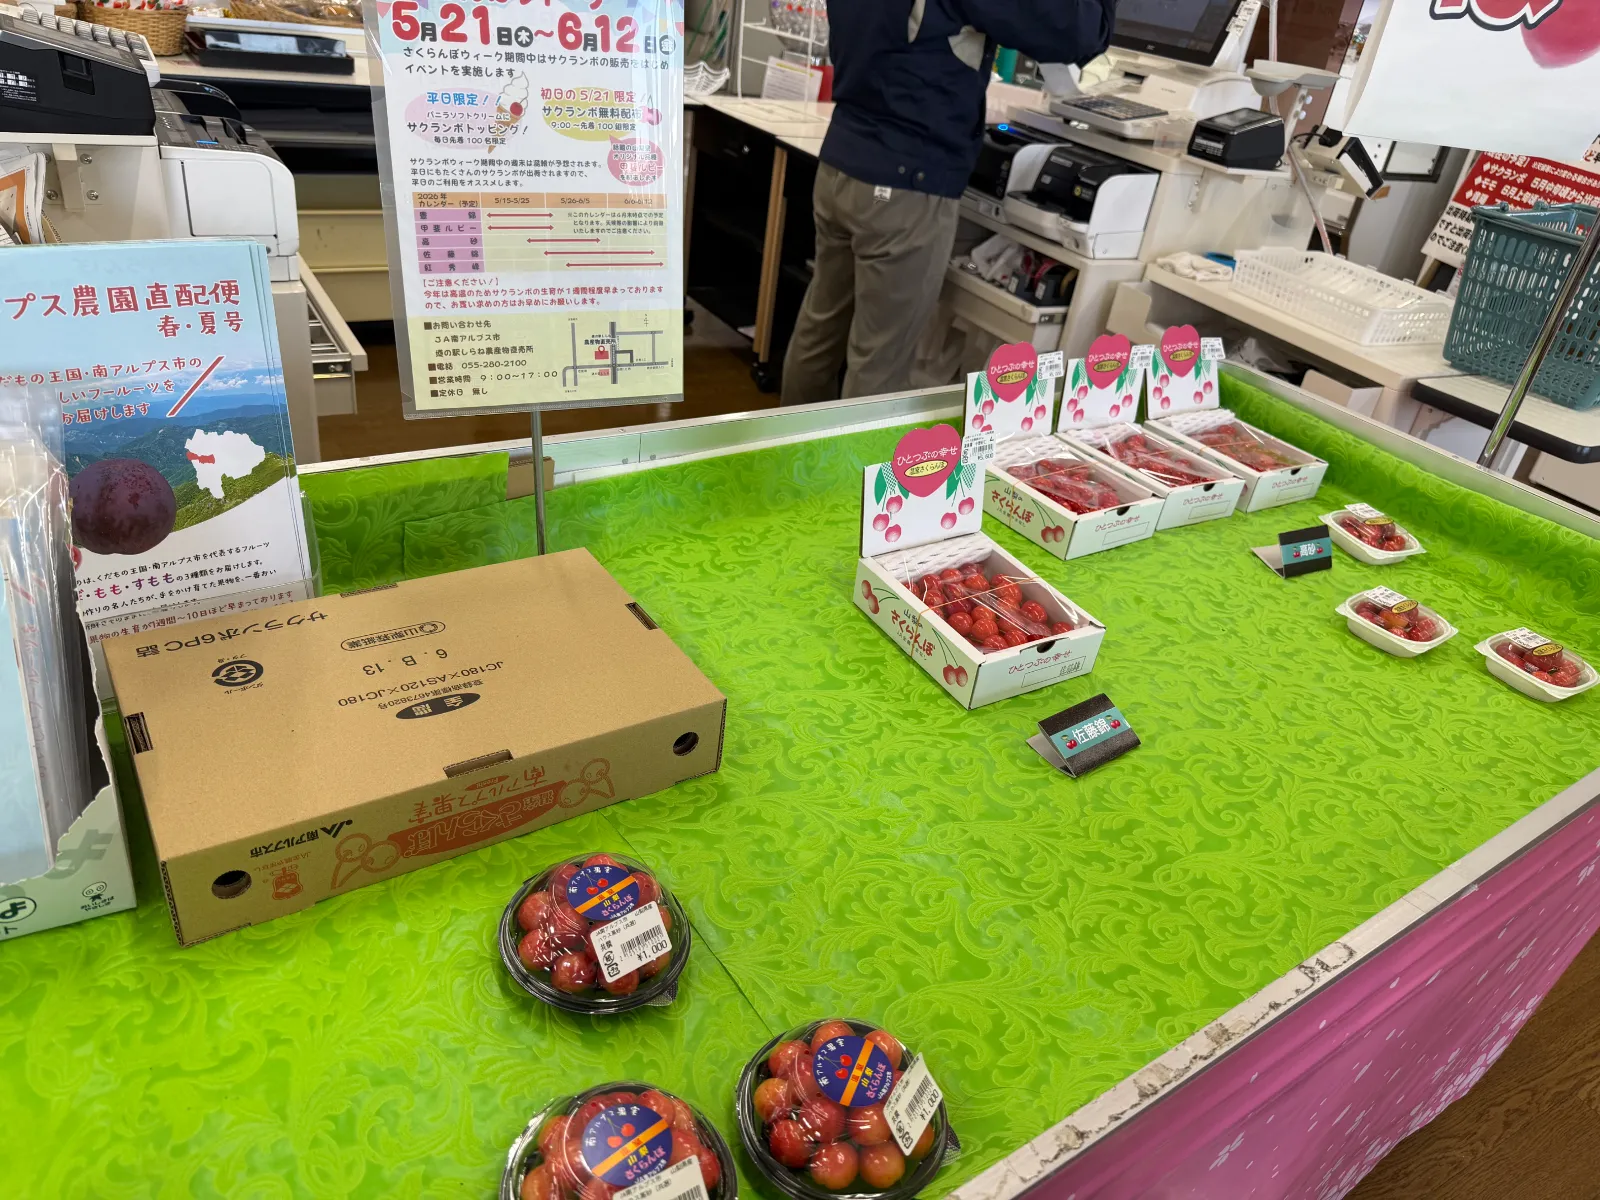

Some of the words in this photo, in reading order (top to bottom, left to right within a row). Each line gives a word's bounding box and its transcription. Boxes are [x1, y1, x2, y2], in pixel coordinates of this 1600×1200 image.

[405, 63, 515, 78] イベントを実施します
[4, 279, 240, 320] プス農園直配便
[157, 311, 244, 338] 春・夏号
[461, 359, 527, 369] 055-280-2100
[990, 360, 1035, 375] ひとつぶの幸せ
[62, 402, 150, 425] お届けします
[897, 446, 958, 466] ひとつぶの幸せ
[1300, 543, 1316, 557] 高砂
[1008, 650, 1072, 674] ひとつぶの幸せ
[1072, 718, 1111, 744] 佐藤錦
